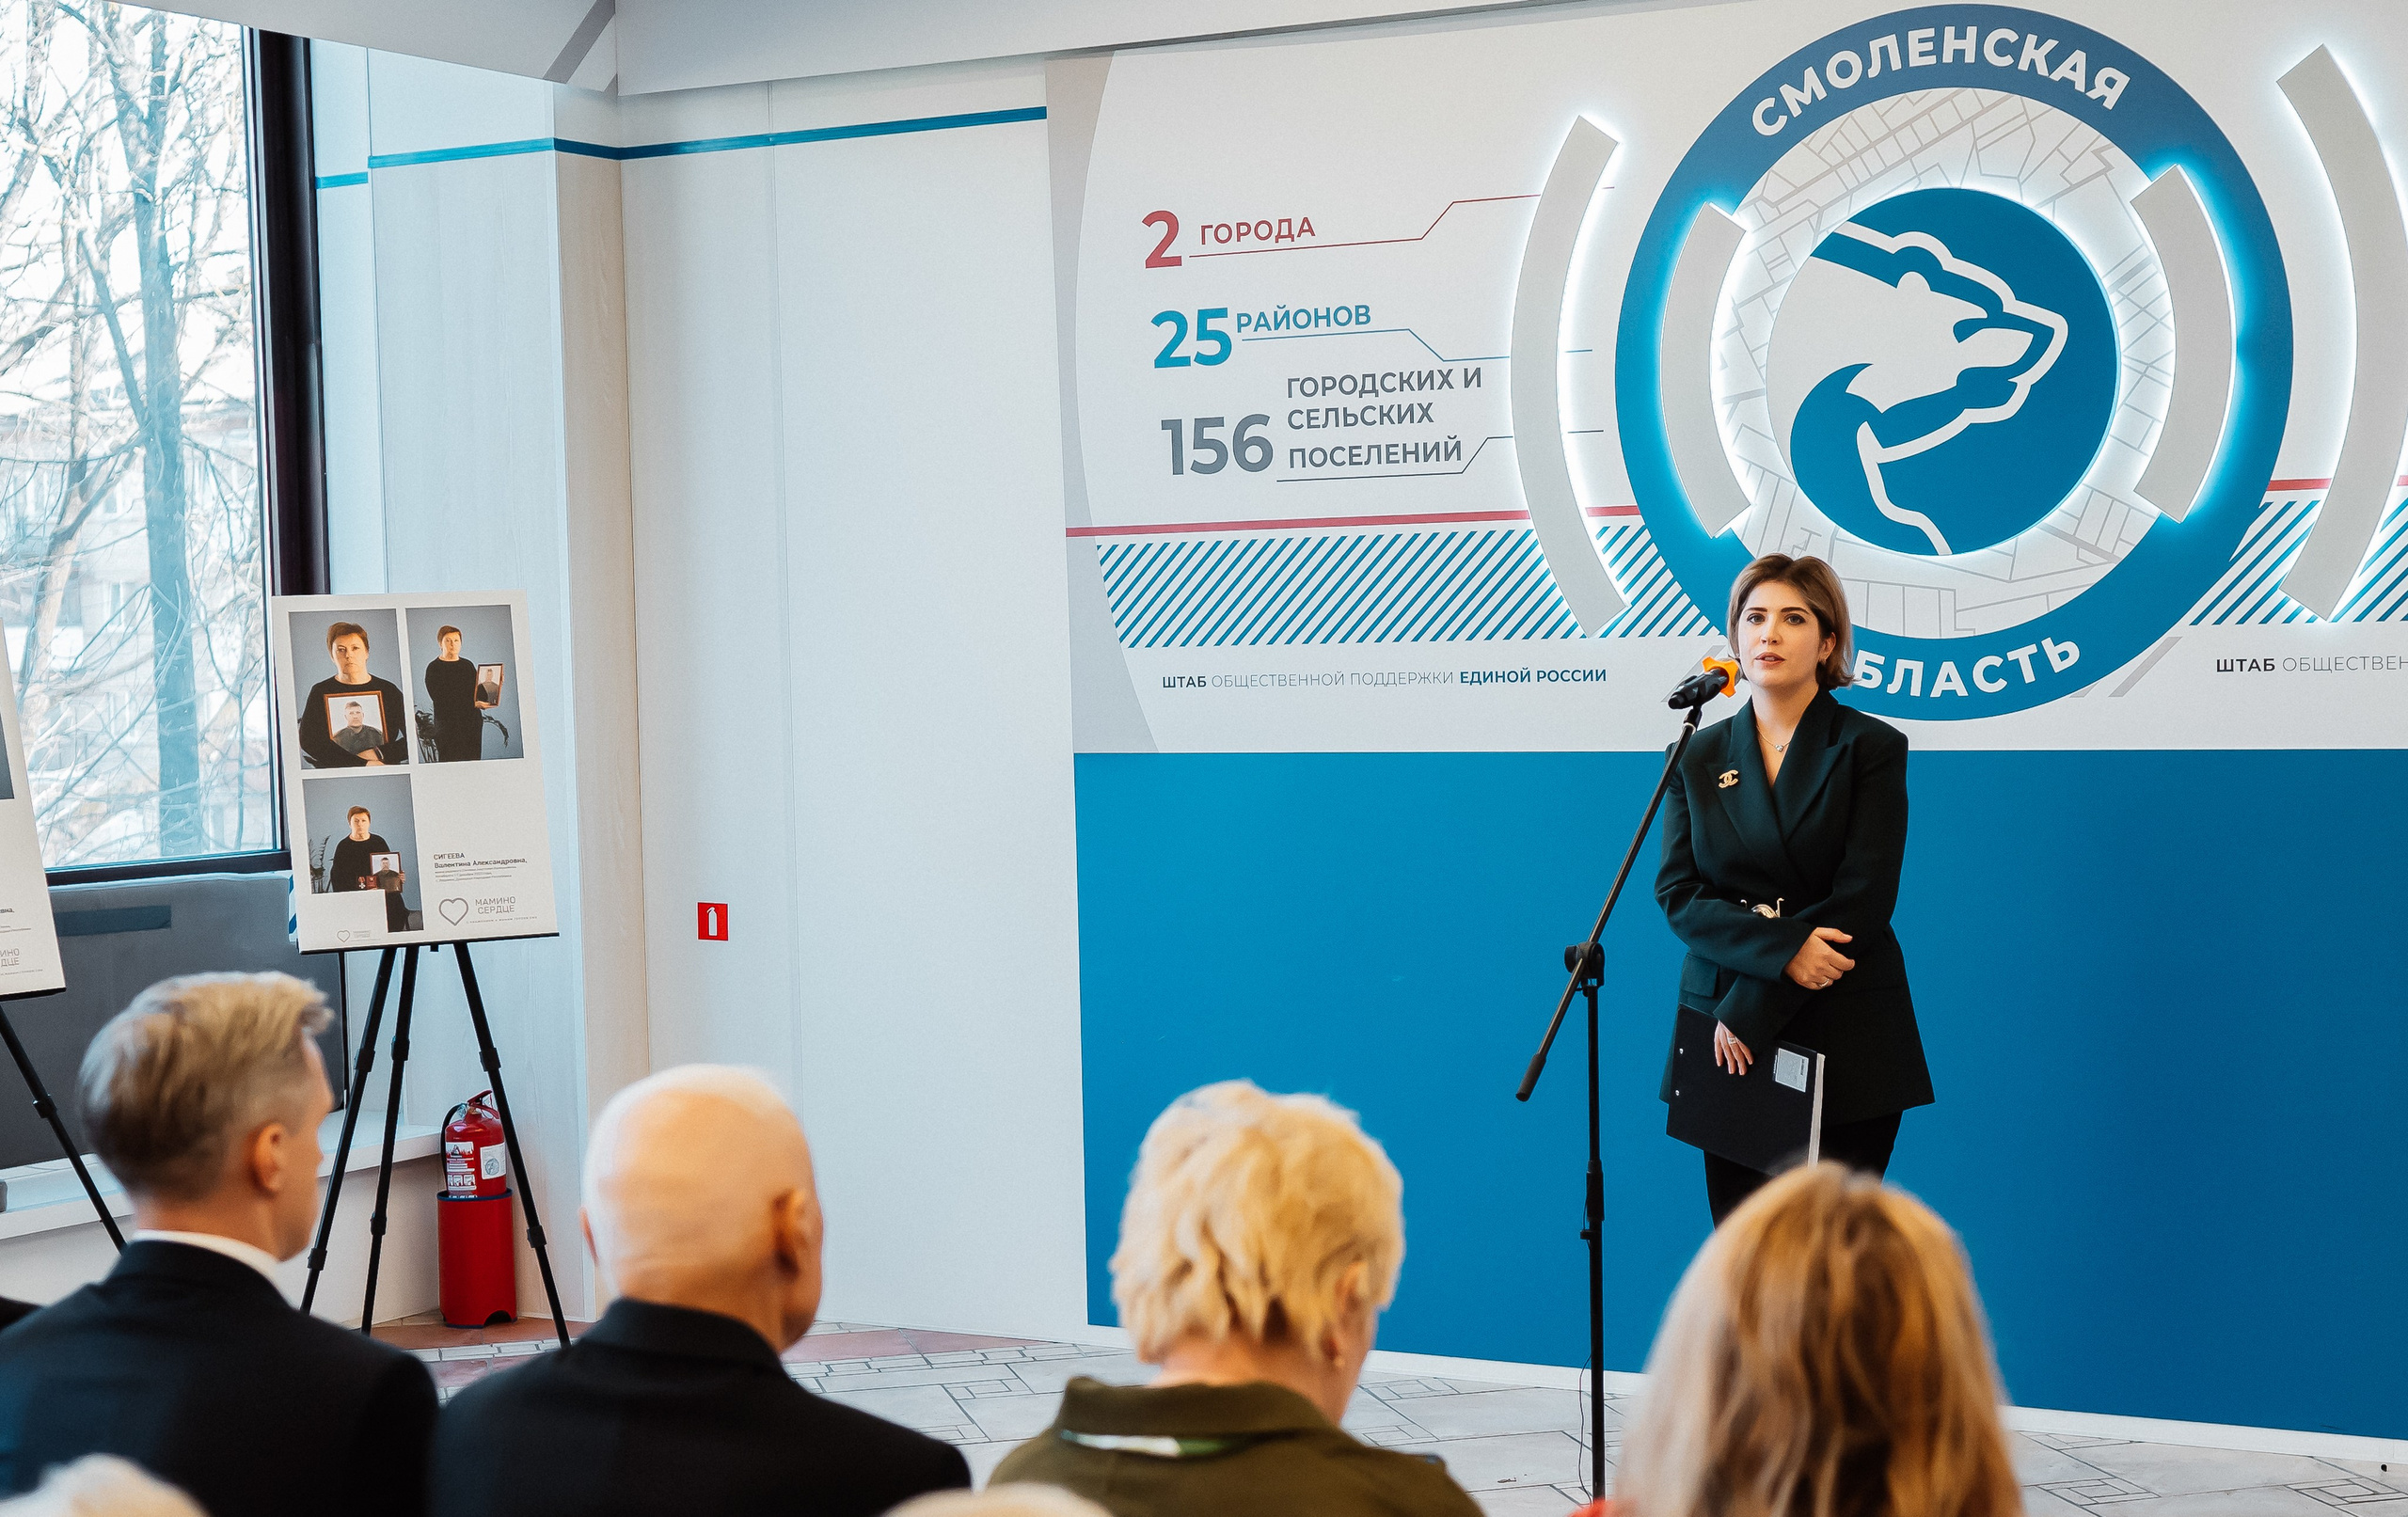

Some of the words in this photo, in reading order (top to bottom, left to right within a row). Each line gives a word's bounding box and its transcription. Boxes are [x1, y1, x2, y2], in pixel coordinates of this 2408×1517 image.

[1752, 25, 2131, 136] СМОЛЕНСКАЯ
[1141, 210, 1182, 269] 2
[1200, 216, 1316, 245] ГОРОДА
[1150, 307, 1232, 370] 25
[1236, 304, 1371, 334] РАЙОНОВ
[1287, 368, 1454, 399] ГОРОДСКИХ
[1463, 367, 1482, 389] И
[1287, 402, 1434, 431] СЕЛЬСКИХ
[1161, 413, 1274, 476] 156
[1289, 435, 1462, 469] ПОСЕЛЕНИЙ
[1162, 675, 1207, 688] ШТАБ
[1211, 671, 1345, 689] ОБЩЕСТВЕННОЙ
[1350, 671, 1453, 687] ПОДДЕРЖКИ
[1460, 666, 1531, 687] ЕДИНОЙ
[1536, 669, 1607, 683] РОССИИ
[1852, 636, 2081, 699] БЛАСТЬ
[2216, 658, 2275, 673] ШТАБ
[475, 895, 516, 907] МАМИНО
[477, 904, 515, 915] СЕРДЦЕ
